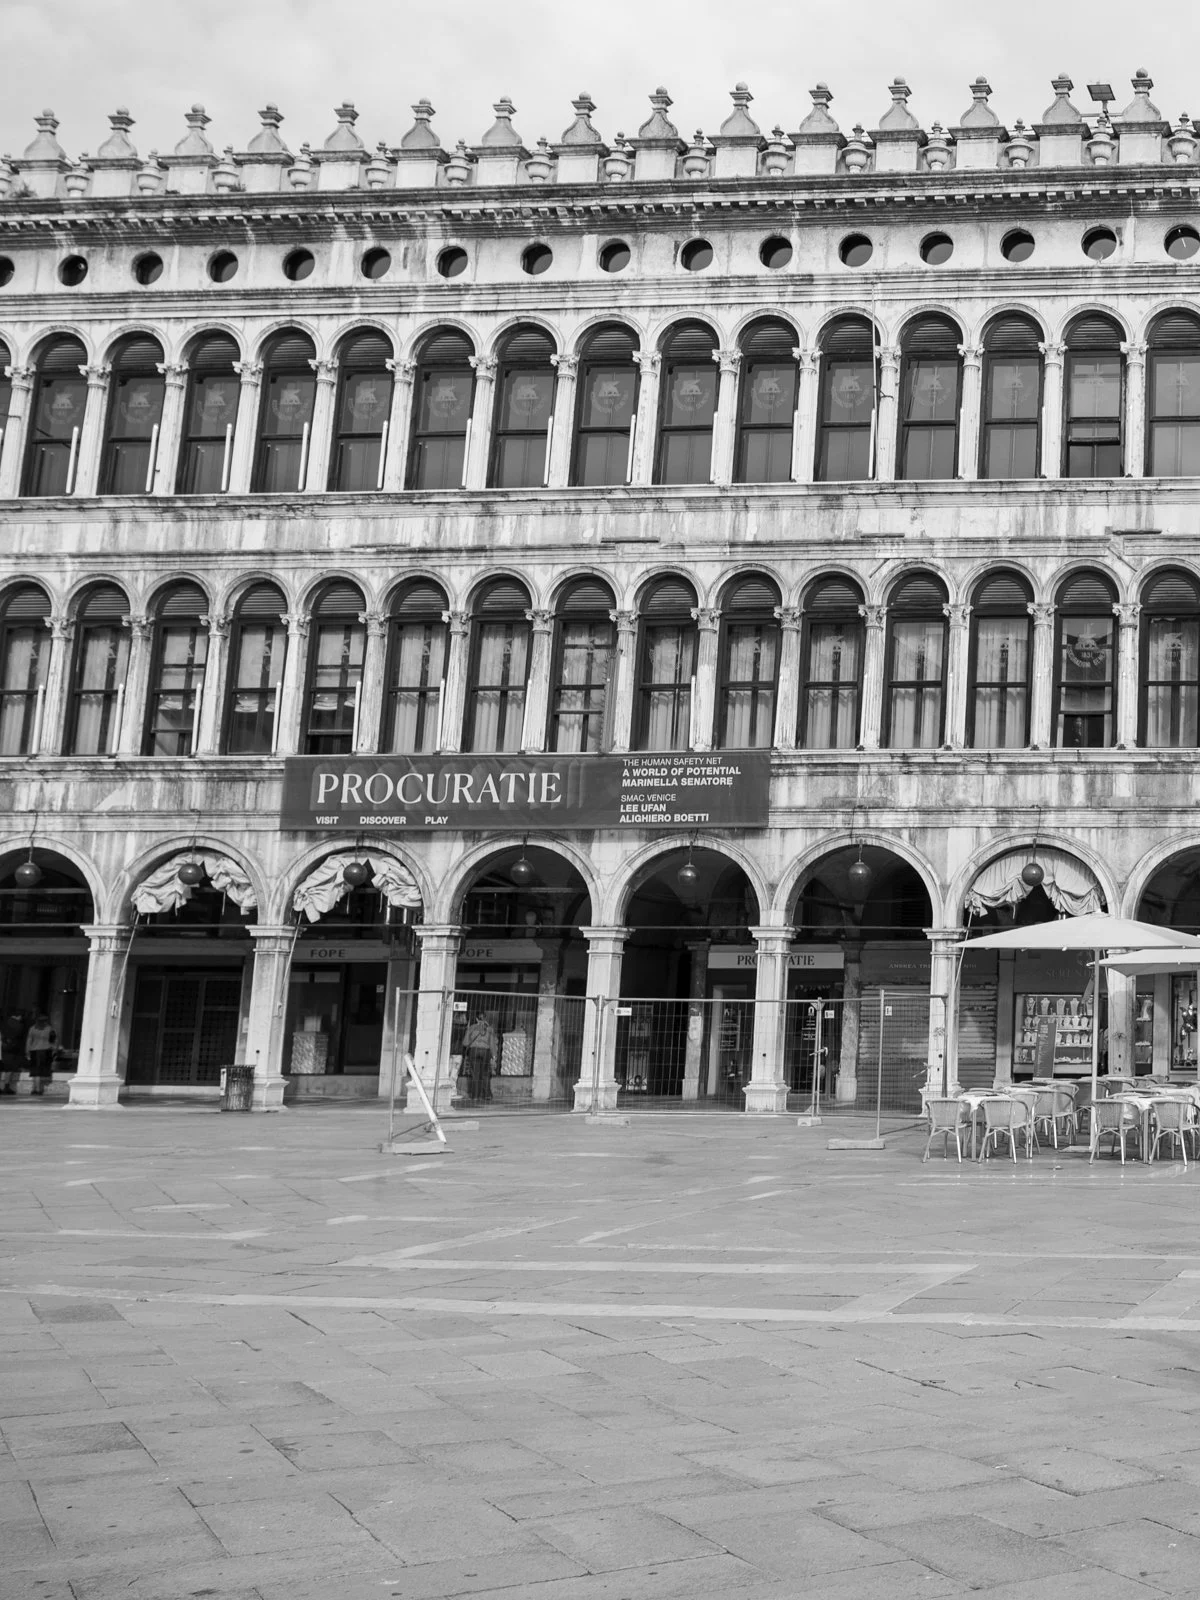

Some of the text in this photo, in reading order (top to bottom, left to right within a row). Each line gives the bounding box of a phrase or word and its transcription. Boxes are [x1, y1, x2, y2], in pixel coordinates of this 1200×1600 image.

[622, 756, 723, 767] THE HUMAN SAFETY NET
[622, 766, 742, 777] A WORLD OF POTENTIAL
[622, 777, 733, 787] MARINELLA SENATORE
[317, 772, 562, 804] PROCURATIE
[620, 793, 677, 803] SMAC VENICE
[620, 803, 667, 813] LEE UFAN
[315, 816, 339, 825] VISIT
[359, 816, 407, 825] DISCOVER
[424, 816, 449, 825] PLAY
[619, 813, 709, 823] ALIGHIERO BOETTI
[310, 948, 346, 958] FOPE
